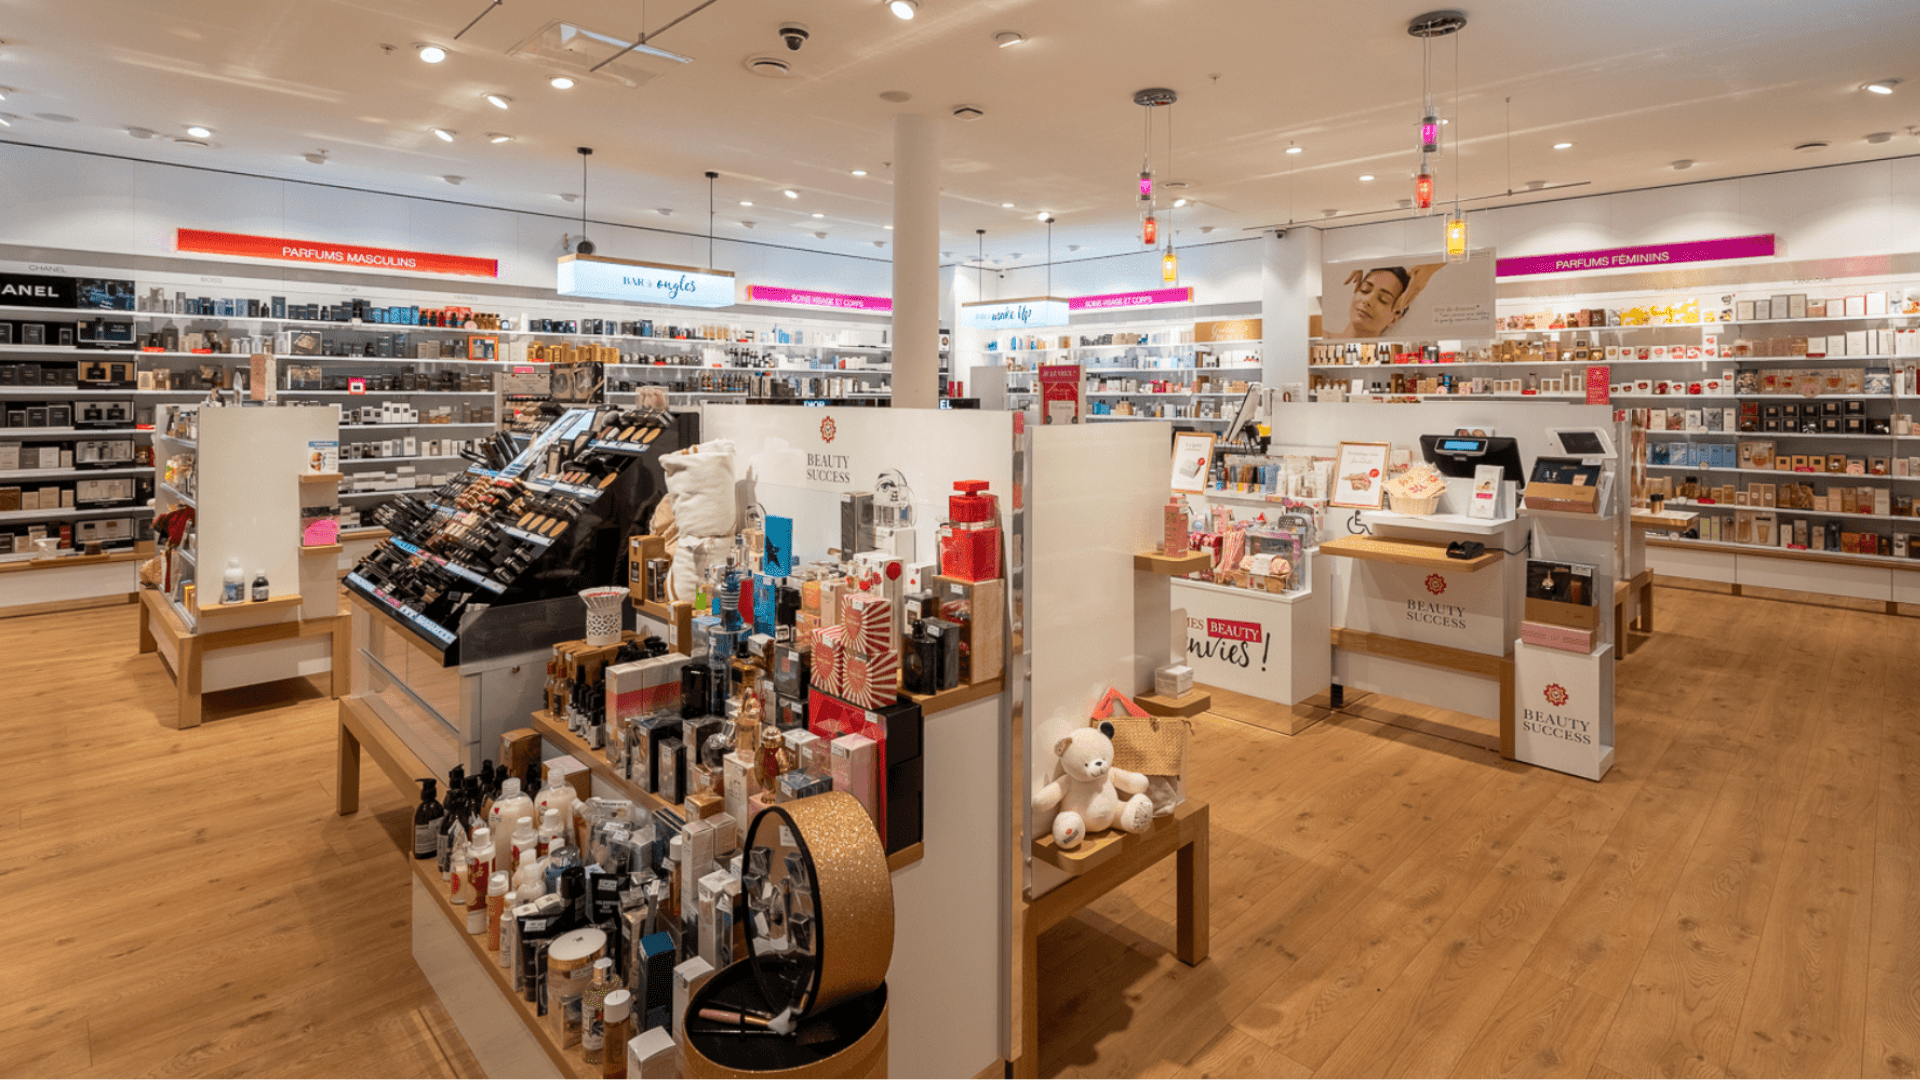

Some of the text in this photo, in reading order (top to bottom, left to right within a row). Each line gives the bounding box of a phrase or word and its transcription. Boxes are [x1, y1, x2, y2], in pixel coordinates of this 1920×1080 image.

[282, 246, 416, 268] PARFUMS MASCULINS
[1555, 251, 1670, 270] PARFUMS FÉMININS
[28, 264, 68, 273] CHANEL
[623, 276, 644, 286] BAR
[656, 274, 696, 300] ongles
[807, 452, 850, 469] BEAUTY
[806, 468, 850, 484] SUCCESS
[1407, 599, 1466, 618] BEAUTY
[1406, 610, 1467, 630] SUCCESS
[1209, 620, 1260, 642] BEAUTY
[1187, 632, 1271, 672] nvies !
[1523, 708, 1591, 733] BEAUTY
[1522, 720, 1591, 745] SUCCESS
